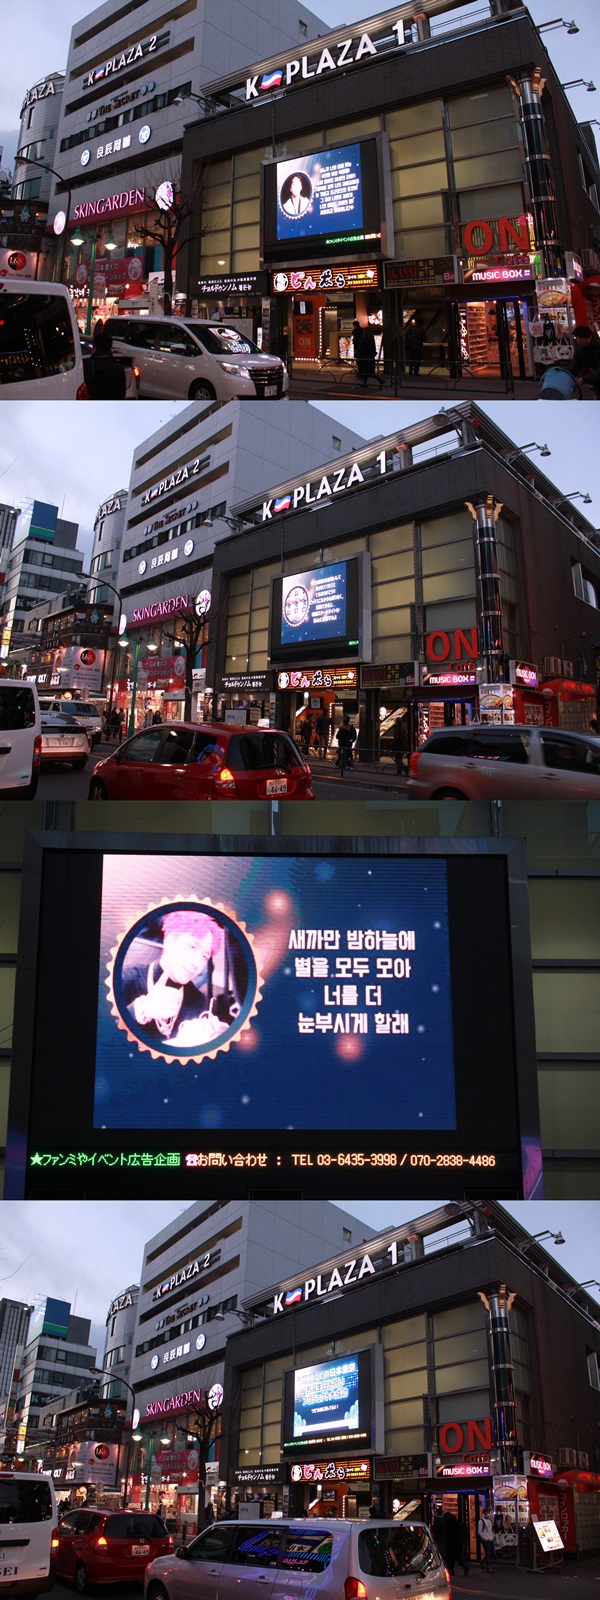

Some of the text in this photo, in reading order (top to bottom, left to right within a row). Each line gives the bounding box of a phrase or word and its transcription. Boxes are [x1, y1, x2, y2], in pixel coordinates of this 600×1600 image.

[88, 35, 157, 86] K PLAZA 2
[246, 19, 404, 100] K PLAZA 1
[74, 187, 146, 220] SKINGARDEN
[463, 215, 530, 255] ON
[472, 271, 500, 281] MUSIC
[502, 270, 523, 278] BOX
[158, 467, 189, 495] PLAZA
[193, 459, 200, 474] 2
[262, 451, 387, 521] K PLAZA 1
[427, 627, 479, 662] ON
[429, 674, 469, 685] MUSIC BOX
[288, 929, 416, 951] 새까만 밤하늘에
[294, 957, 411, 978] 별을 모두 모아
[324, 985, 382, 1006] 너를 더
[298, 1012, 409, 1034] 눈부시게 할래
[197, 1152, 268, 1167] お問い合わせ
[291, 1154, 313, 1166] TEL
[317, 1154, 397, 1166] 03-6435-3998
[410, 1155, 496, 1167] 070-2838-4486
[170, 1261, 200, 1290] PLAZA
[203, 1253, 211, 1268] 2
[273, 1241, 398, 1314] K PLAZA 1
[439, 1418, 493, 1453] ON
[443, 1466, 482, 1475] MUSIC BOX
